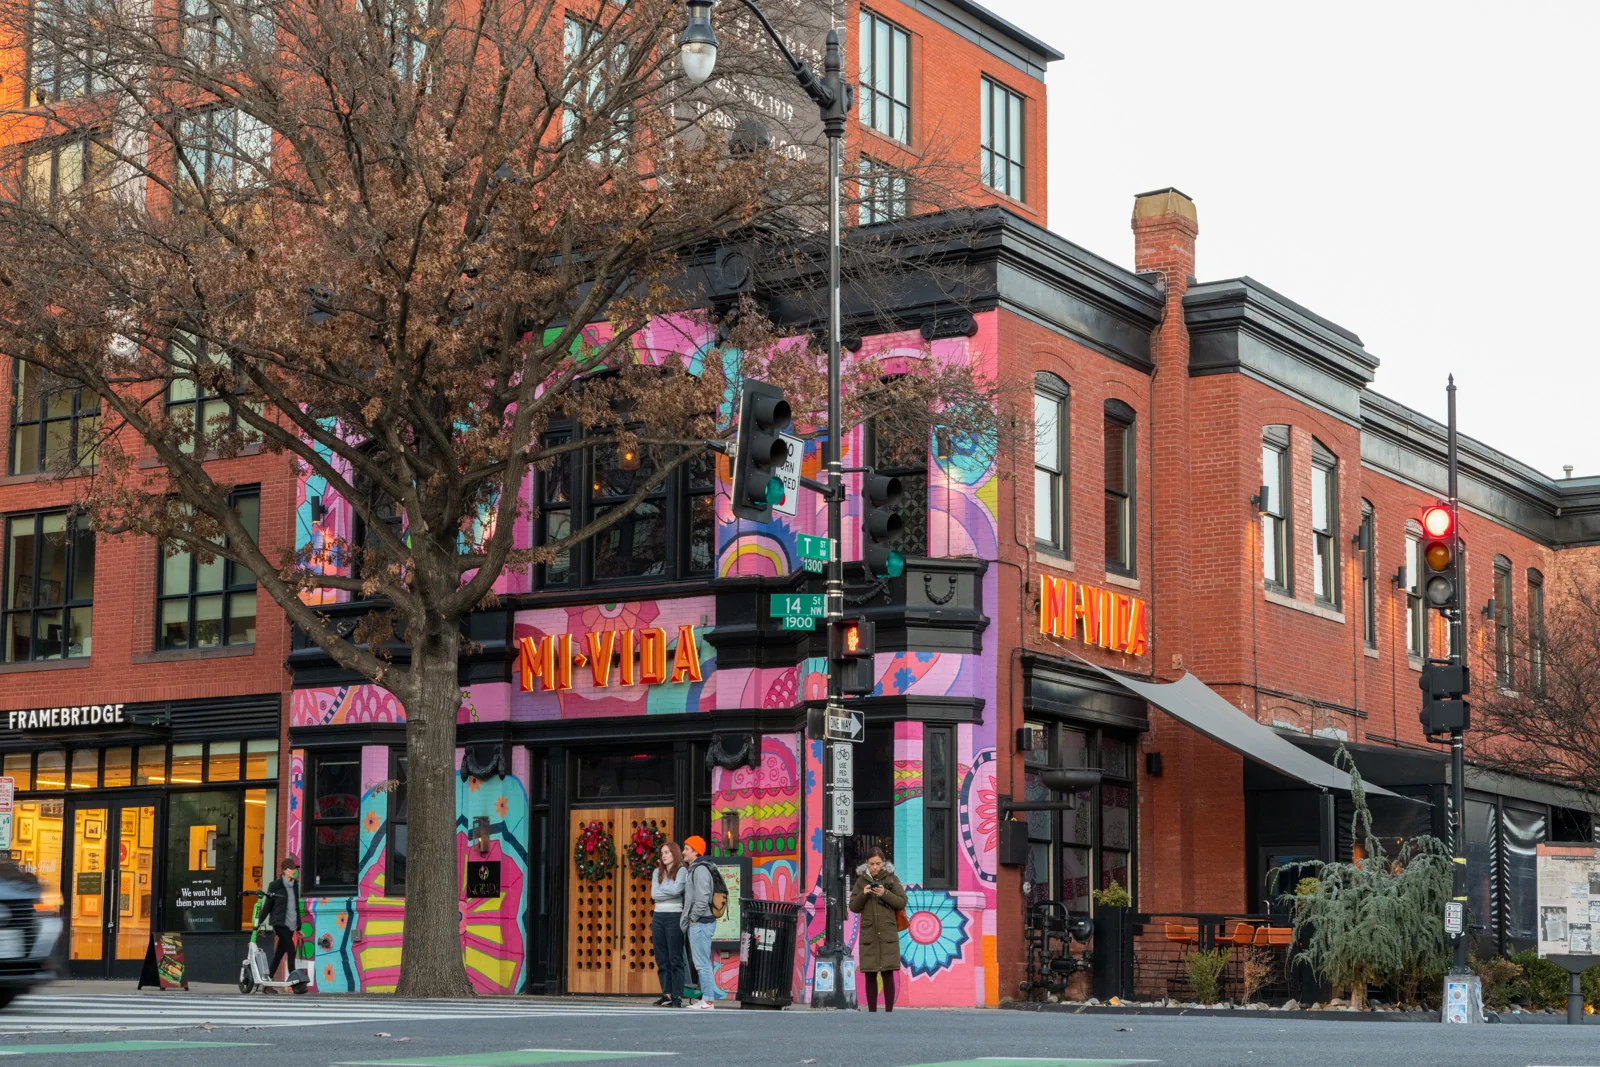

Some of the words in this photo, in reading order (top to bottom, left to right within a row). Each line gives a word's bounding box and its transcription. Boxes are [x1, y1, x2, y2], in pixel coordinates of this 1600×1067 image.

[804, 538, 811, 554] T
[804, 558, 822, 572] 1300
[786, 598, 802, 614] 14
[812, 596, 820, 604] St
[810, 607, 822, 616] NW
[786, 617, 812, 628] 1900
[9, 704, 124, 730] FRAMEBRIDGE
[830, 717, 840, 730] ONE
[841, 718, 852, 731] WAY
[182, 888, 192, 897] We
[193, 888, 210, 897] won't
[212, 886, 222, 896] tell
[176, 898, 192, 907] them
[206, 896, 226, 906] waited
